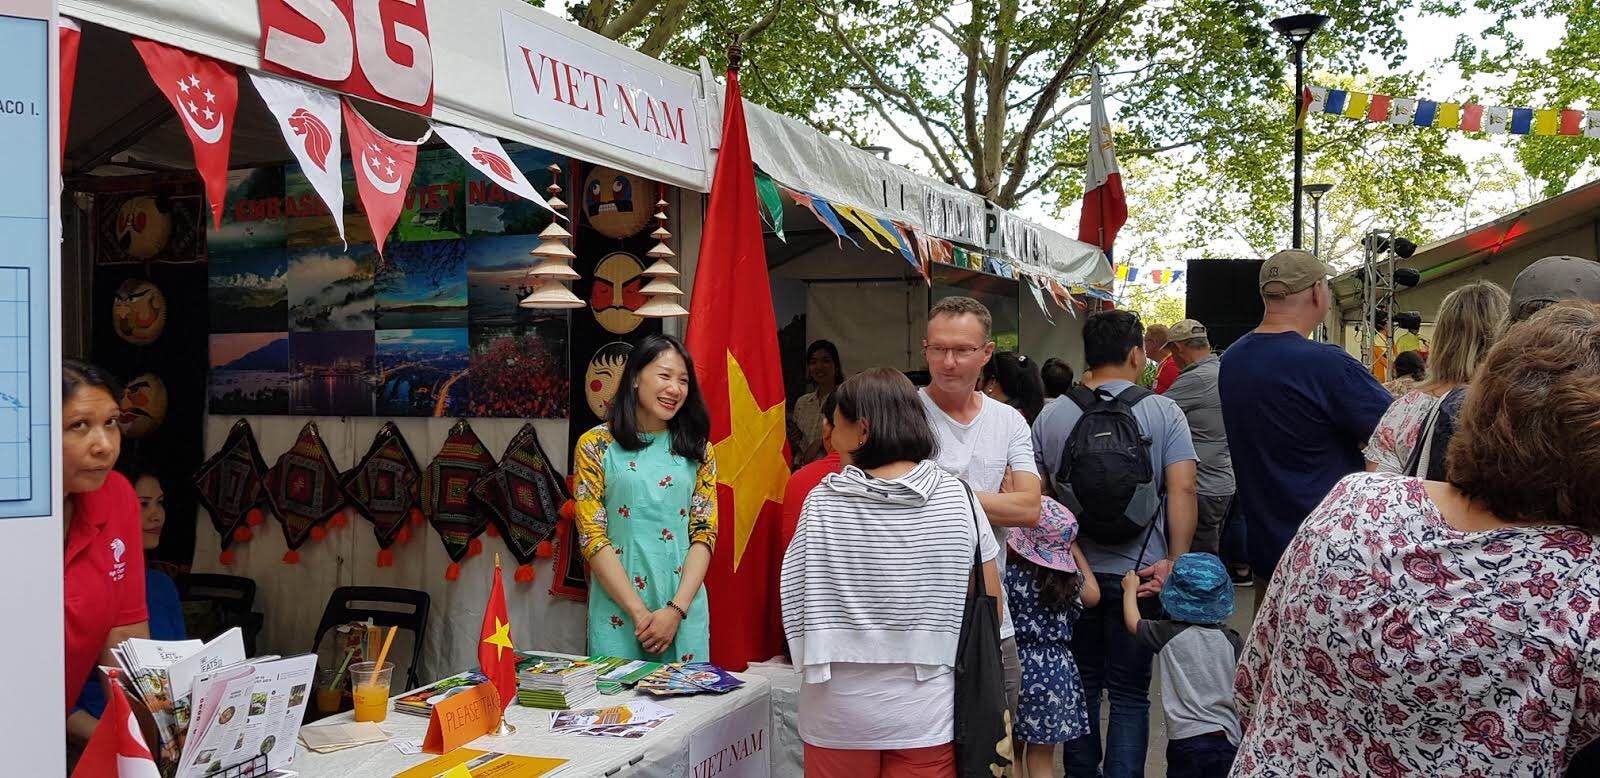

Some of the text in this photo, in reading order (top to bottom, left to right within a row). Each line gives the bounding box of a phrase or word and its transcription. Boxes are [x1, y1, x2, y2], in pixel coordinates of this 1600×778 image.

[264, 0, 433, 107] SG
[518, 45, 688, 145] VIET NAM
[446, 698, 481, 733] PLEASE
[728, 729, 764, 767] NAM
